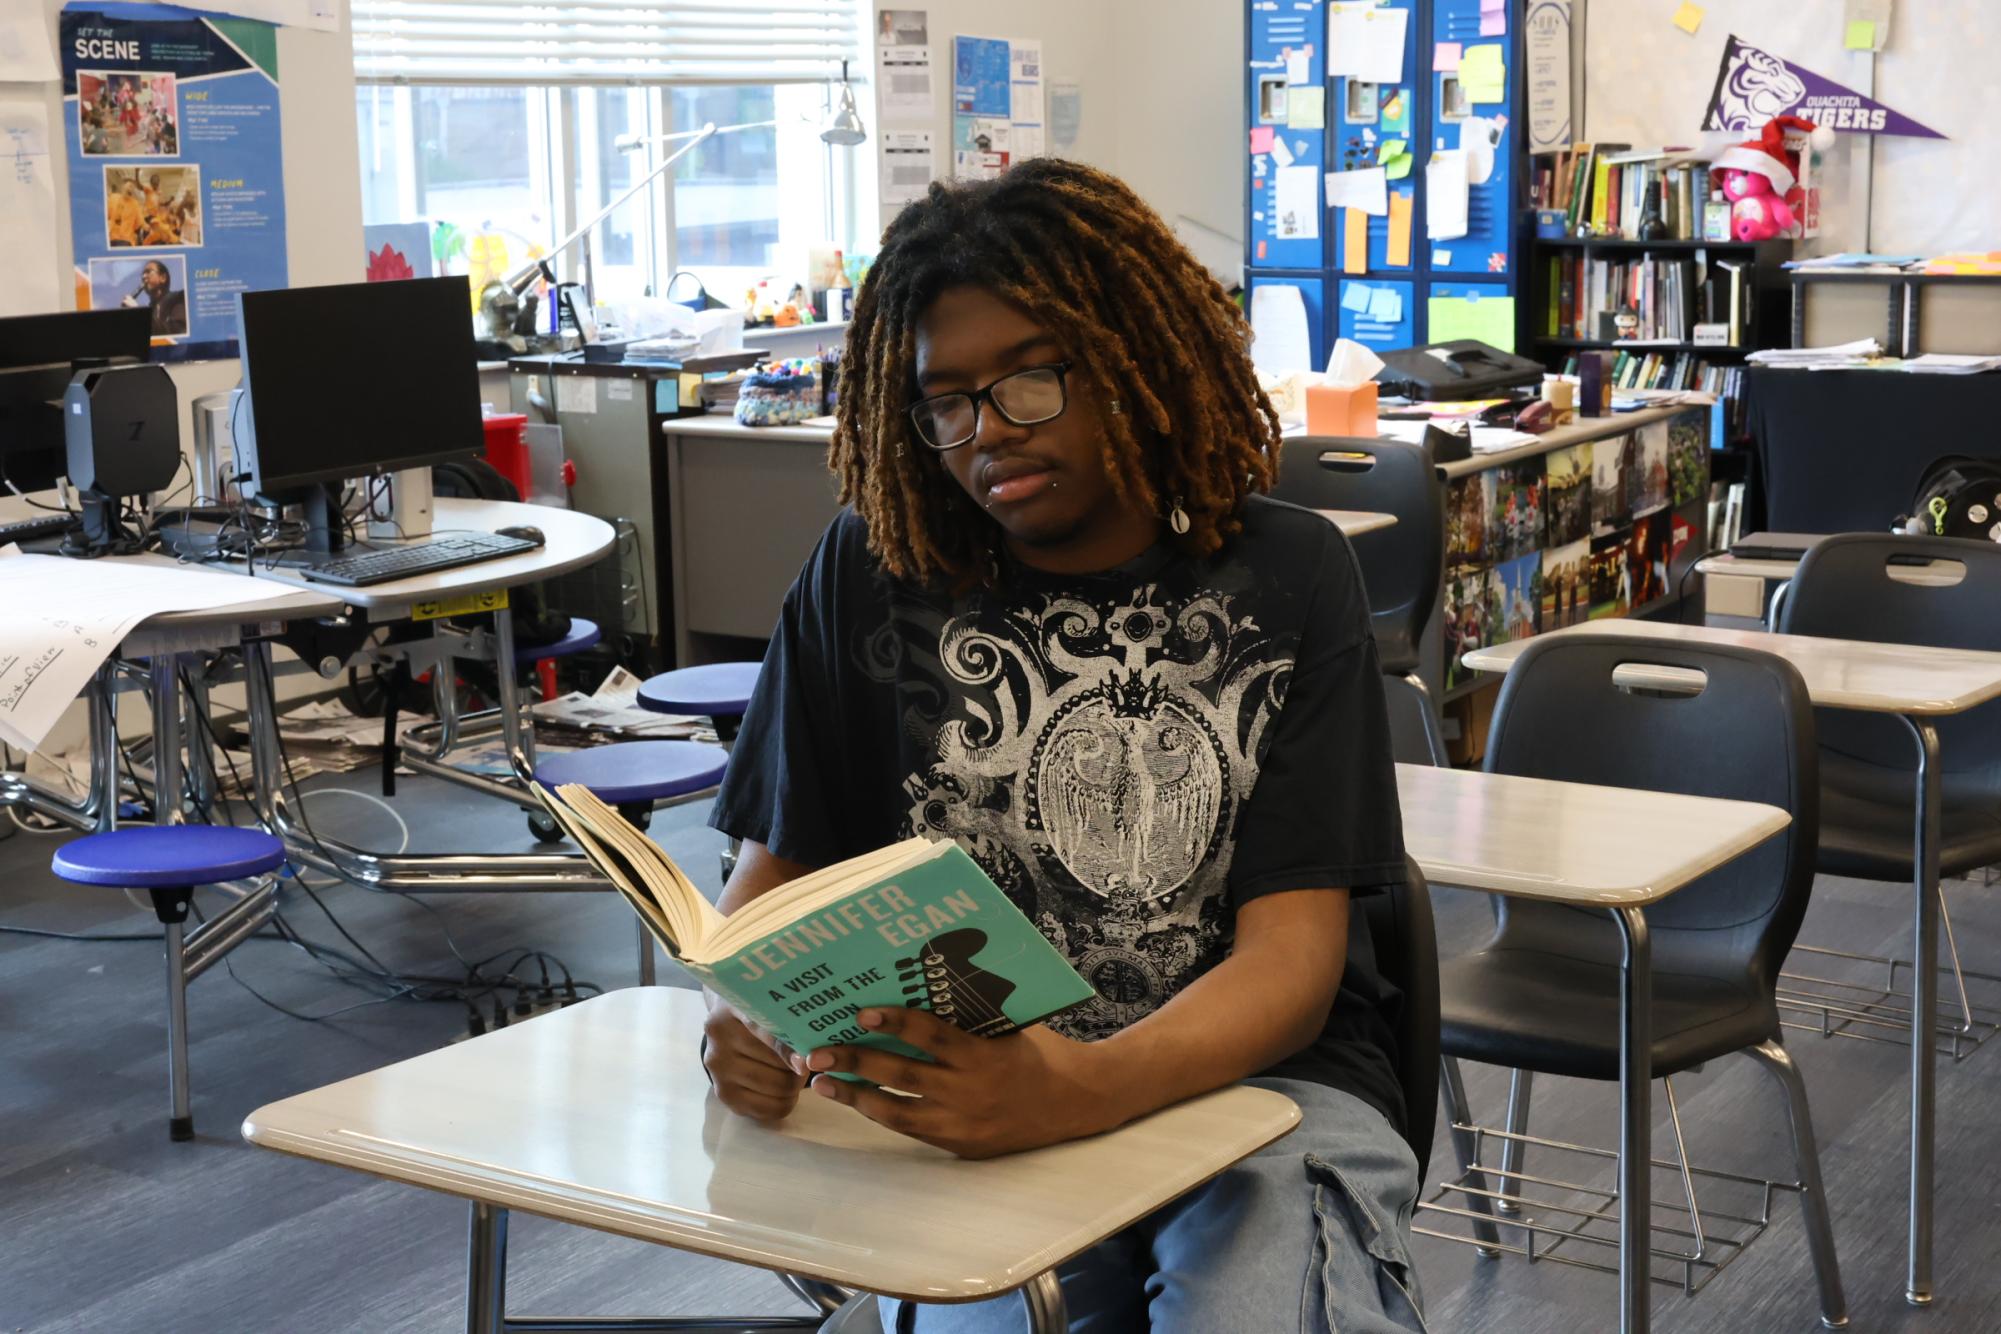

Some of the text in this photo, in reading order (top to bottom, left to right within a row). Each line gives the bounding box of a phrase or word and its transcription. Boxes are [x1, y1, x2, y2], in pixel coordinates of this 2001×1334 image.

[77, 27, 113, 38] SET THE
[75, 38, 141, 60] SCENE
[1806, 96, 1861, 108] OUACHITA
[1795, 107, 1887, 131] TIGERS
[875, 888, 981, 949] EGAN
[739, 885, 915, 981] JENNIFER
[767, 962, 835, 1003] A VISIT
[787, 988, 846, 1018] FROM
[843, 967, 886, 992] THE
[807, 1002, 861, 1034] GOON
[827, 1027, 872, 1047] SQU
